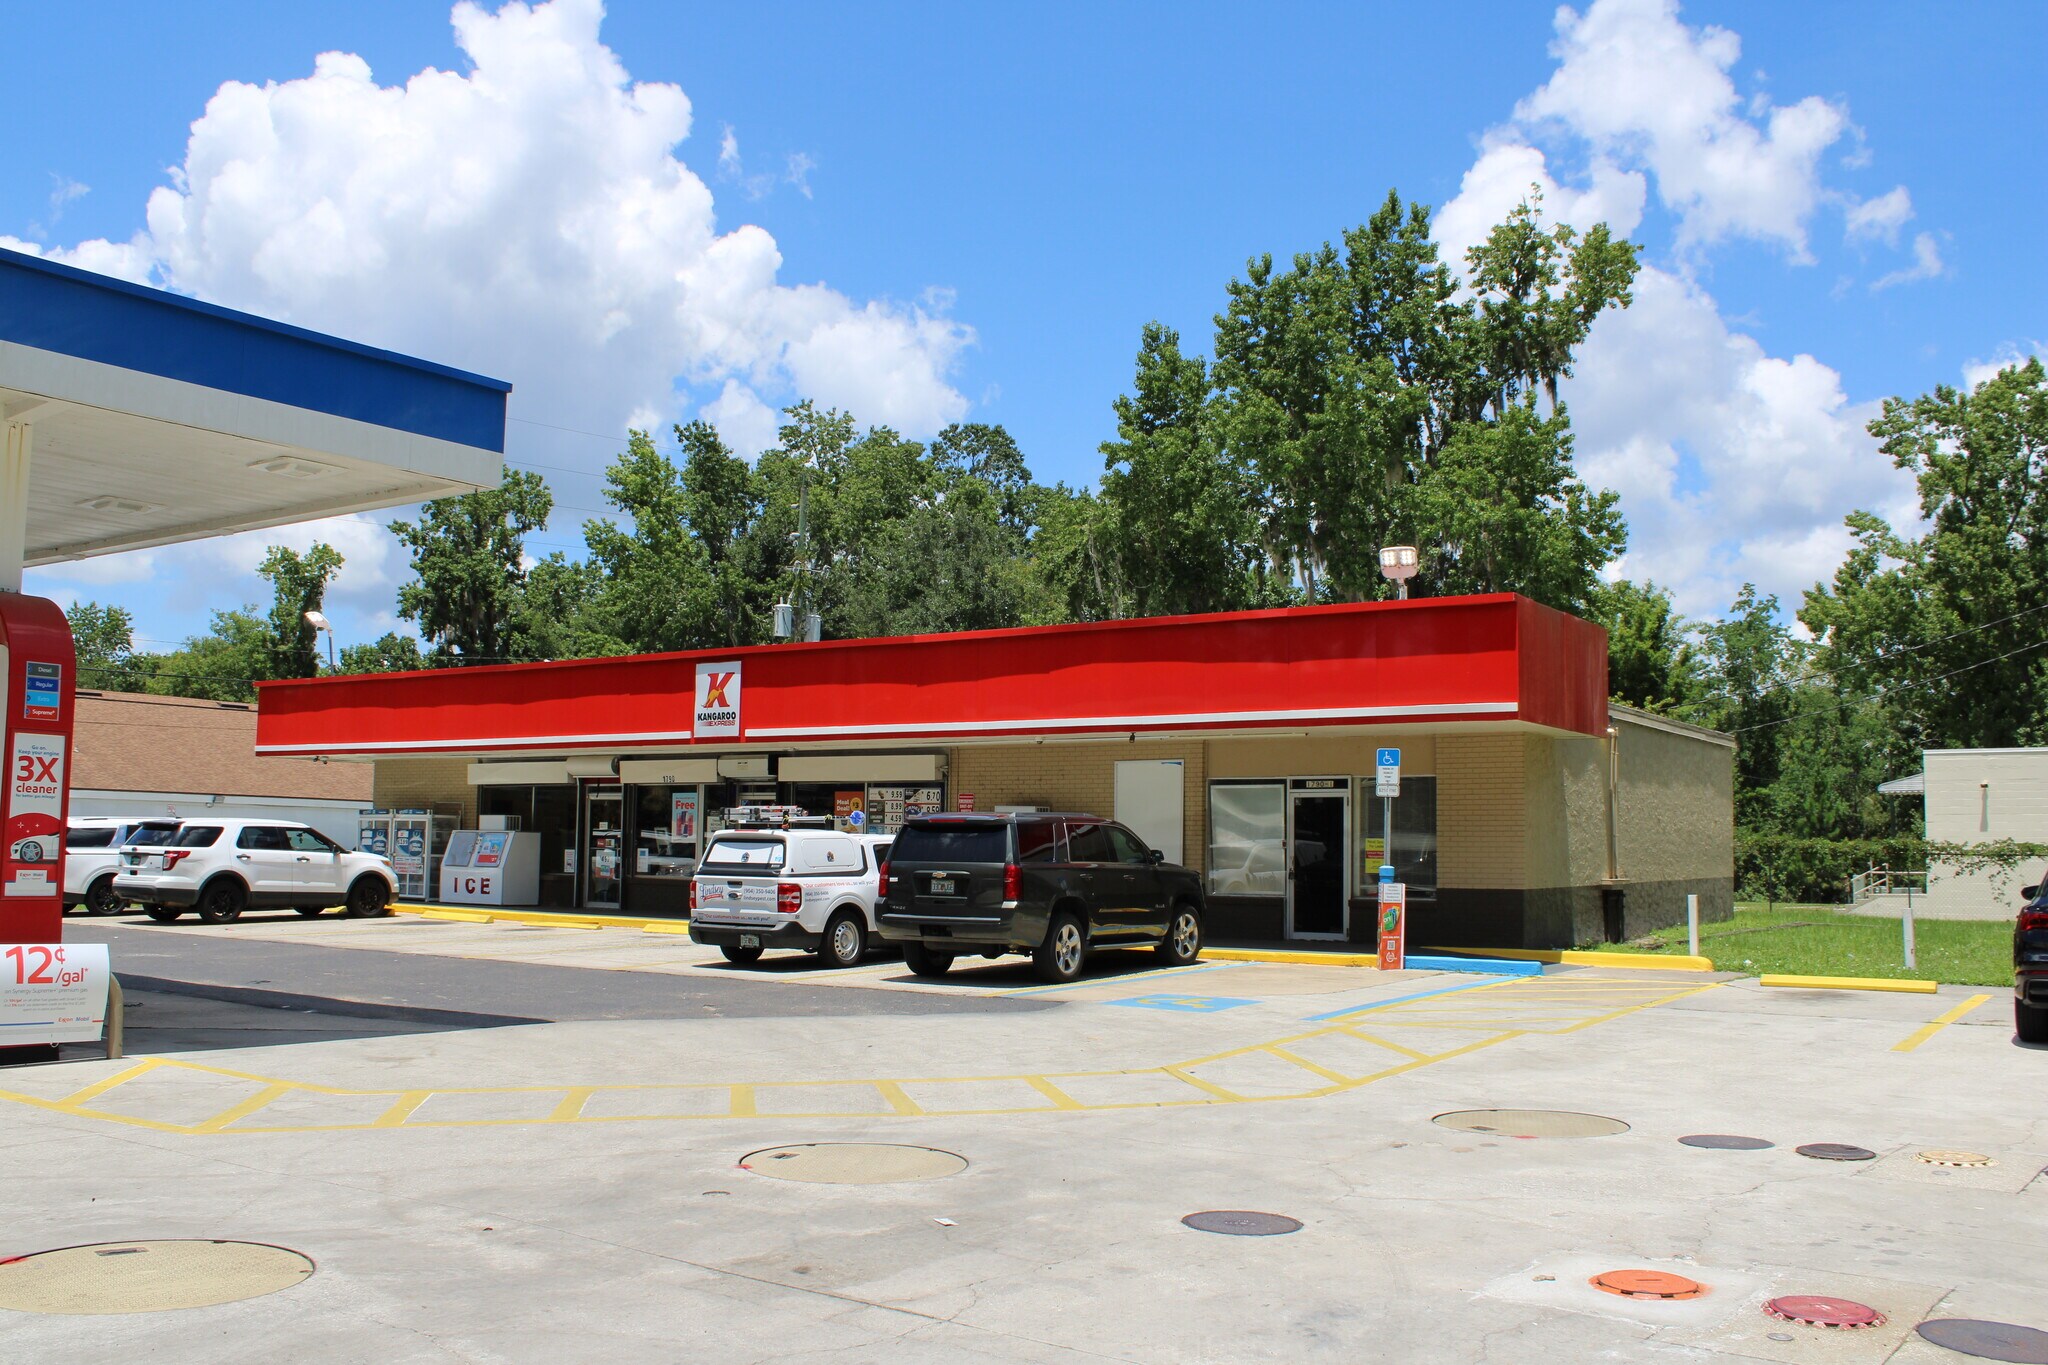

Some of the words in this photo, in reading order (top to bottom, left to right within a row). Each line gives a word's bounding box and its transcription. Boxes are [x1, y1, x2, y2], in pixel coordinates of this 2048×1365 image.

[702, 671, 735, 709] K
[697, 711, 736, 721] KANGAROO
[17, 755, 59, 783] 3X
[16, 782, 57, 794] cleaner
[926, 791, 941, 802] 6.70
[675, 800, 695, 809] Free
[453, 877, 491, 895] ICE
[699, 883, 724, 899] Lindsey
[12, 987, 31, 995] Synergy
[58, 986, 79, 994] premium
